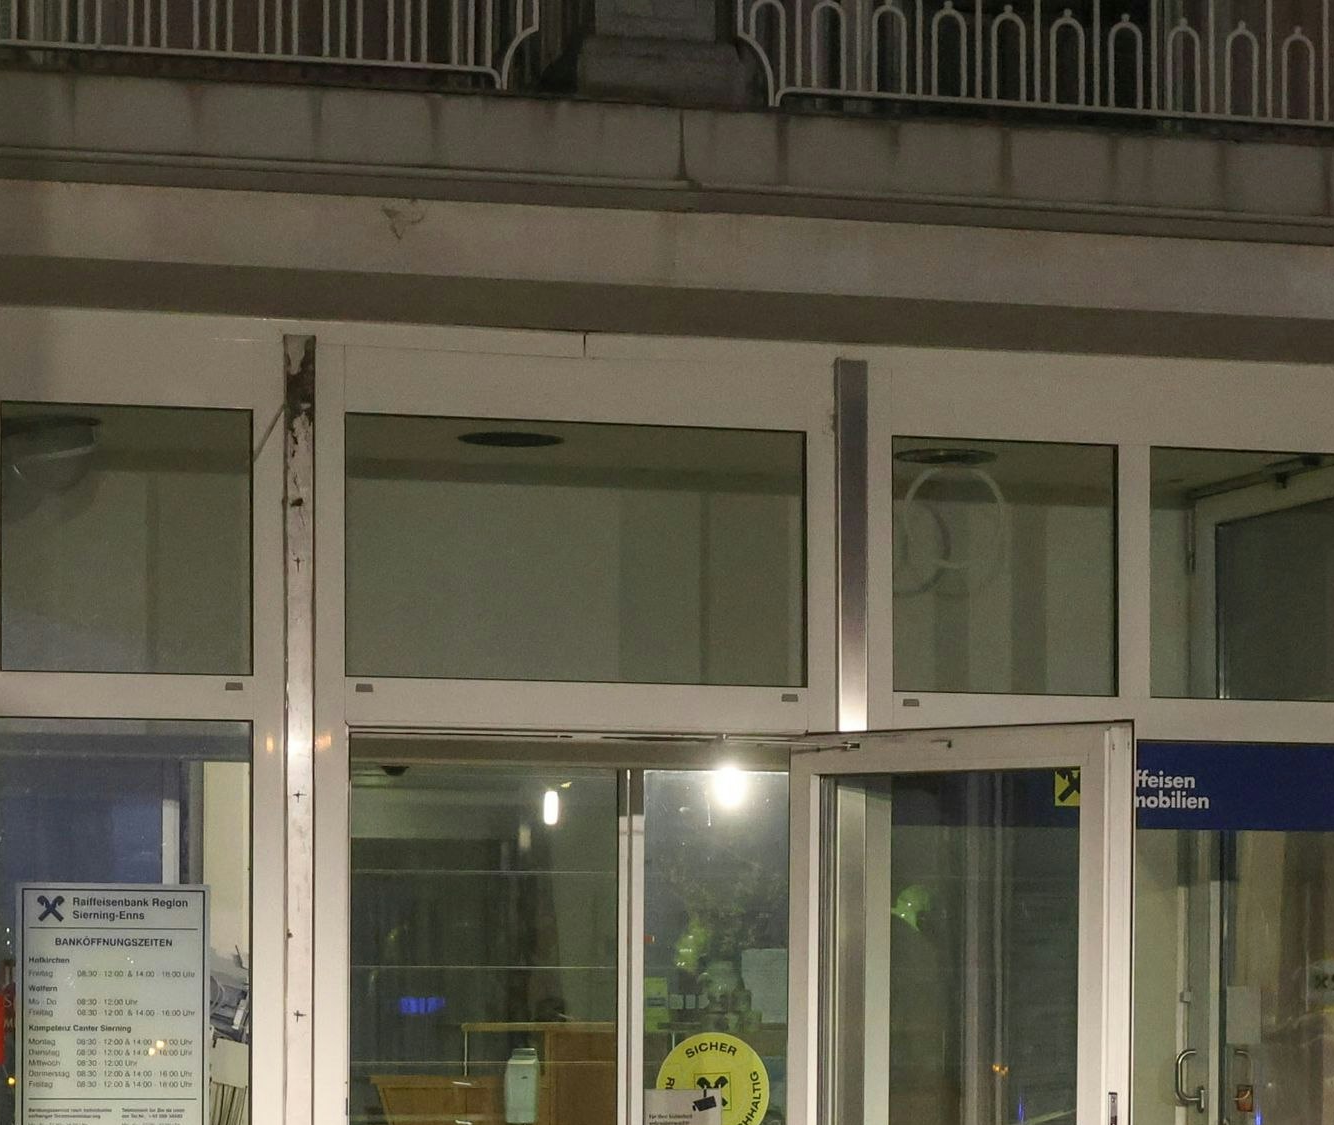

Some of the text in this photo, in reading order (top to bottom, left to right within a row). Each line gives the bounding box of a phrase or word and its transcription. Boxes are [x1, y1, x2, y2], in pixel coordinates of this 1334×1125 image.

[73, 897, 189, 909] Raiffeisenbank Region
[73, 910, 145, 921] Sierning-Enns
[55, 936, 173, 947] BANKÖFFNUNGSZEITEN
[685, 1042, 738, 1058] SICHER
